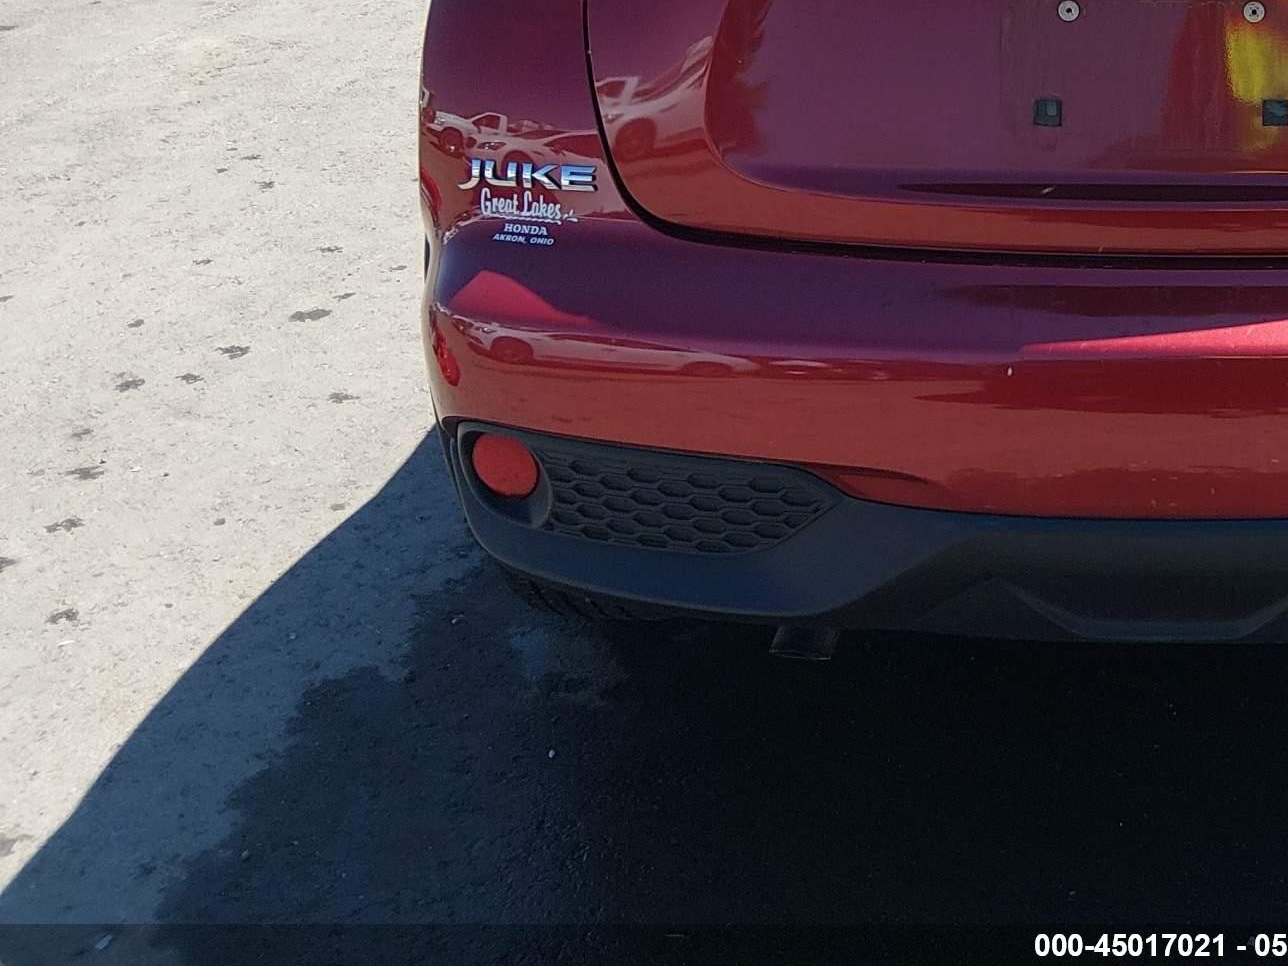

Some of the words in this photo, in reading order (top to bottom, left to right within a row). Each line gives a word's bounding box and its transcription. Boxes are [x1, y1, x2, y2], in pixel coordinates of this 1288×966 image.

[457, 158, 598, 192] JUKE
[480, 188, 520, 216] Great
[521, 190, 562, 220] Lakes
[492, 233, 527, 245] AKRON,
[529, 236, 554, 246] OHIO
[503, 223, 548, 235] HONDA
